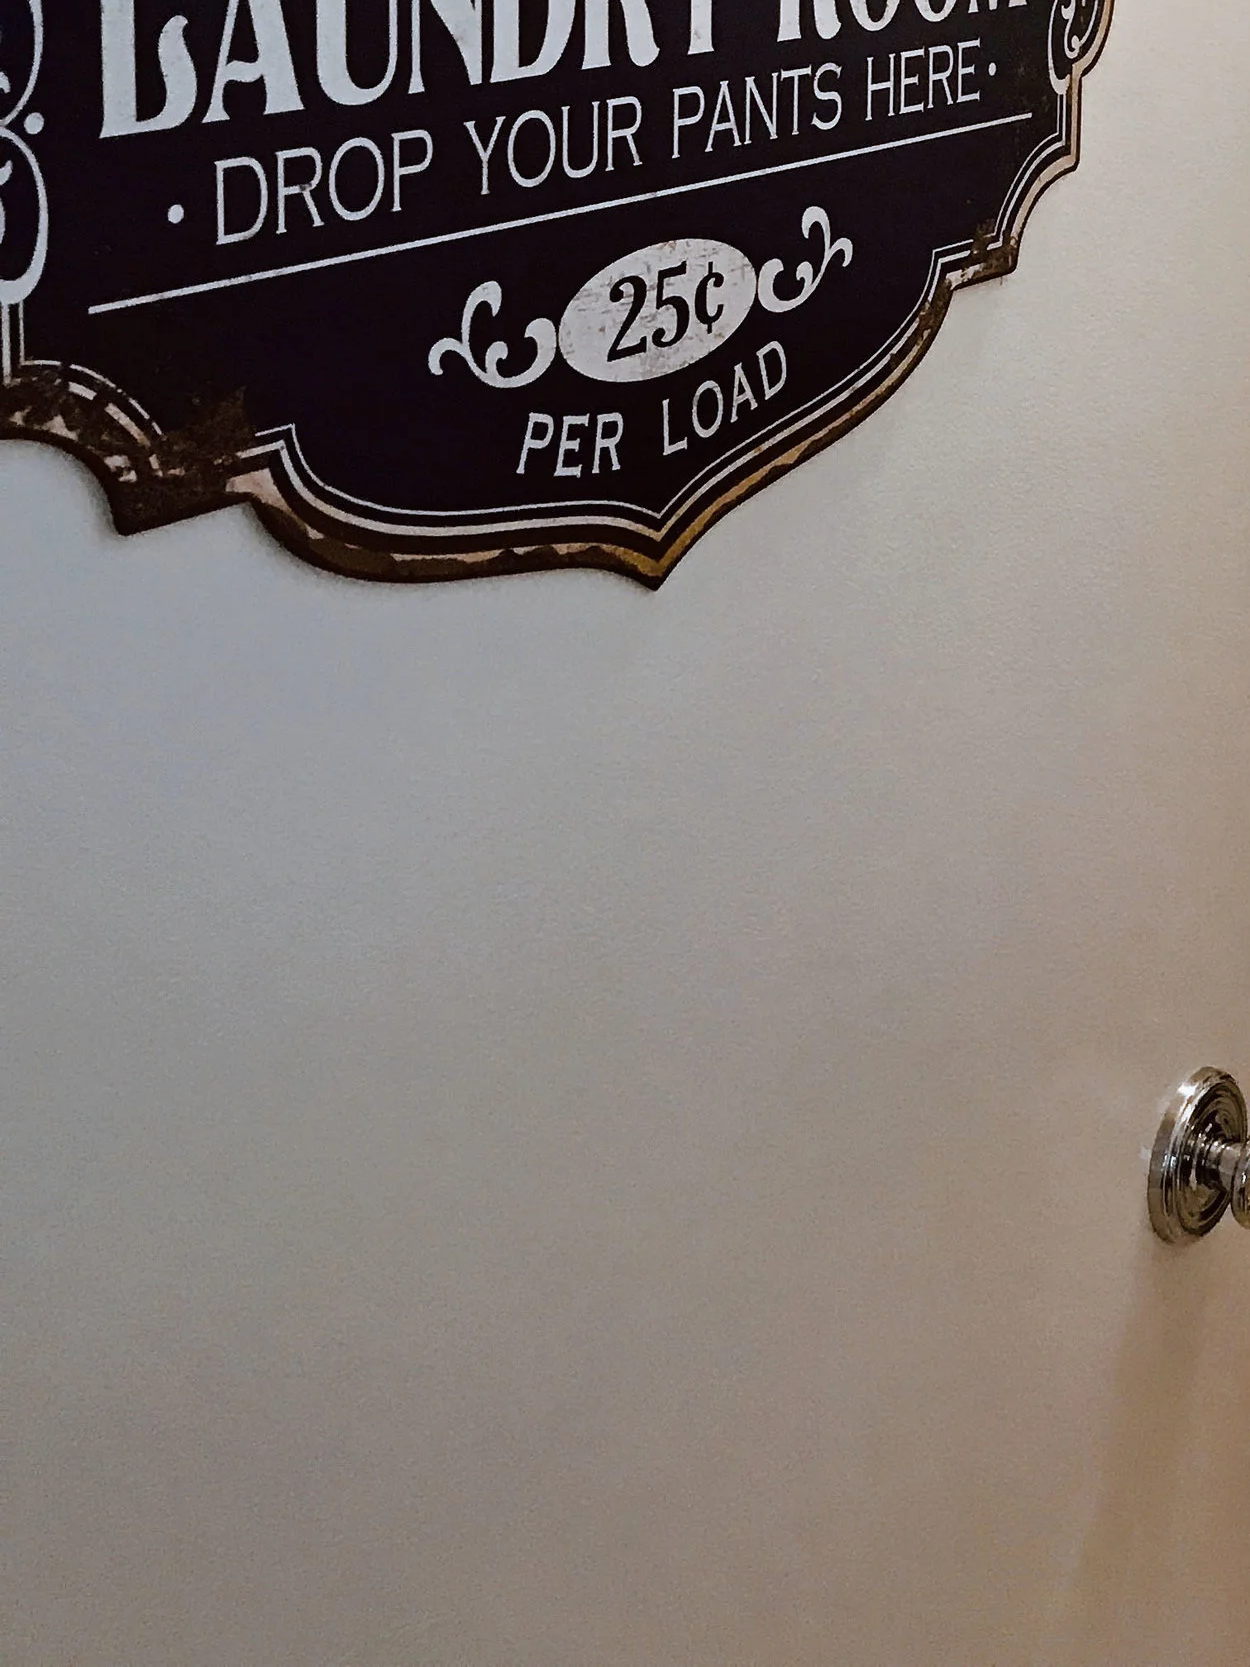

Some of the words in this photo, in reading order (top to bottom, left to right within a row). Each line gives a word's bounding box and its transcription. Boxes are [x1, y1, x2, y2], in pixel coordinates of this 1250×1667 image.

[213, 129, 433, 246] DROP
[463, 95, 643, 196] YOUR
[671, 62, 842, 159] PANTS
[865, 37, 981, 121] HERE
[607, 260, 725, 363] 25¢
[516, 411, 624, 479] PER
[662, 340, 787, 456] LOAD
